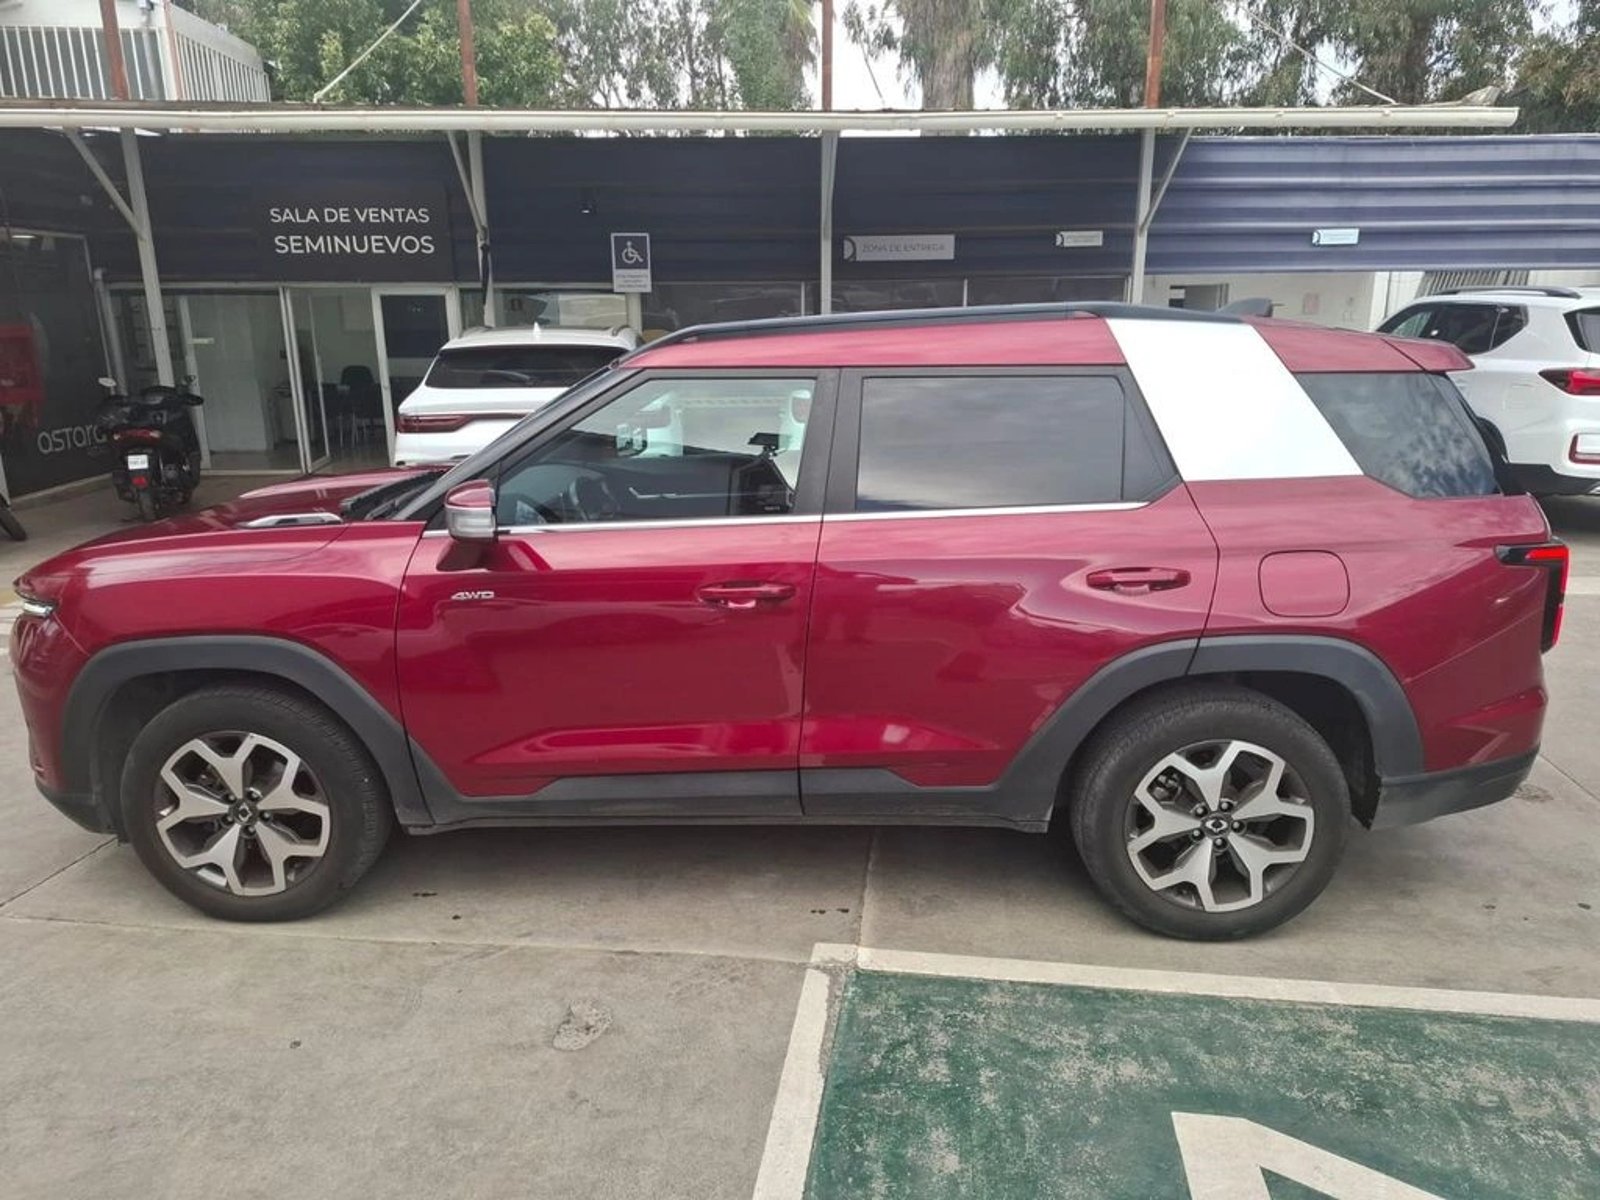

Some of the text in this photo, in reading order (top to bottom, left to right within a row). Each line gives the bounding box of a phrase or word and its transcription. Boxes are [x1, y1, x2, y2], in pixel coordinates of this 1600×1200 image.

[269, 207, 430, 224] SALA DE VENTAS
[274, 234, 435, 255] SEMINUEVOS
[862, 243, 887, 253] ZONA
[451, 591, 495, 601] 4WD
